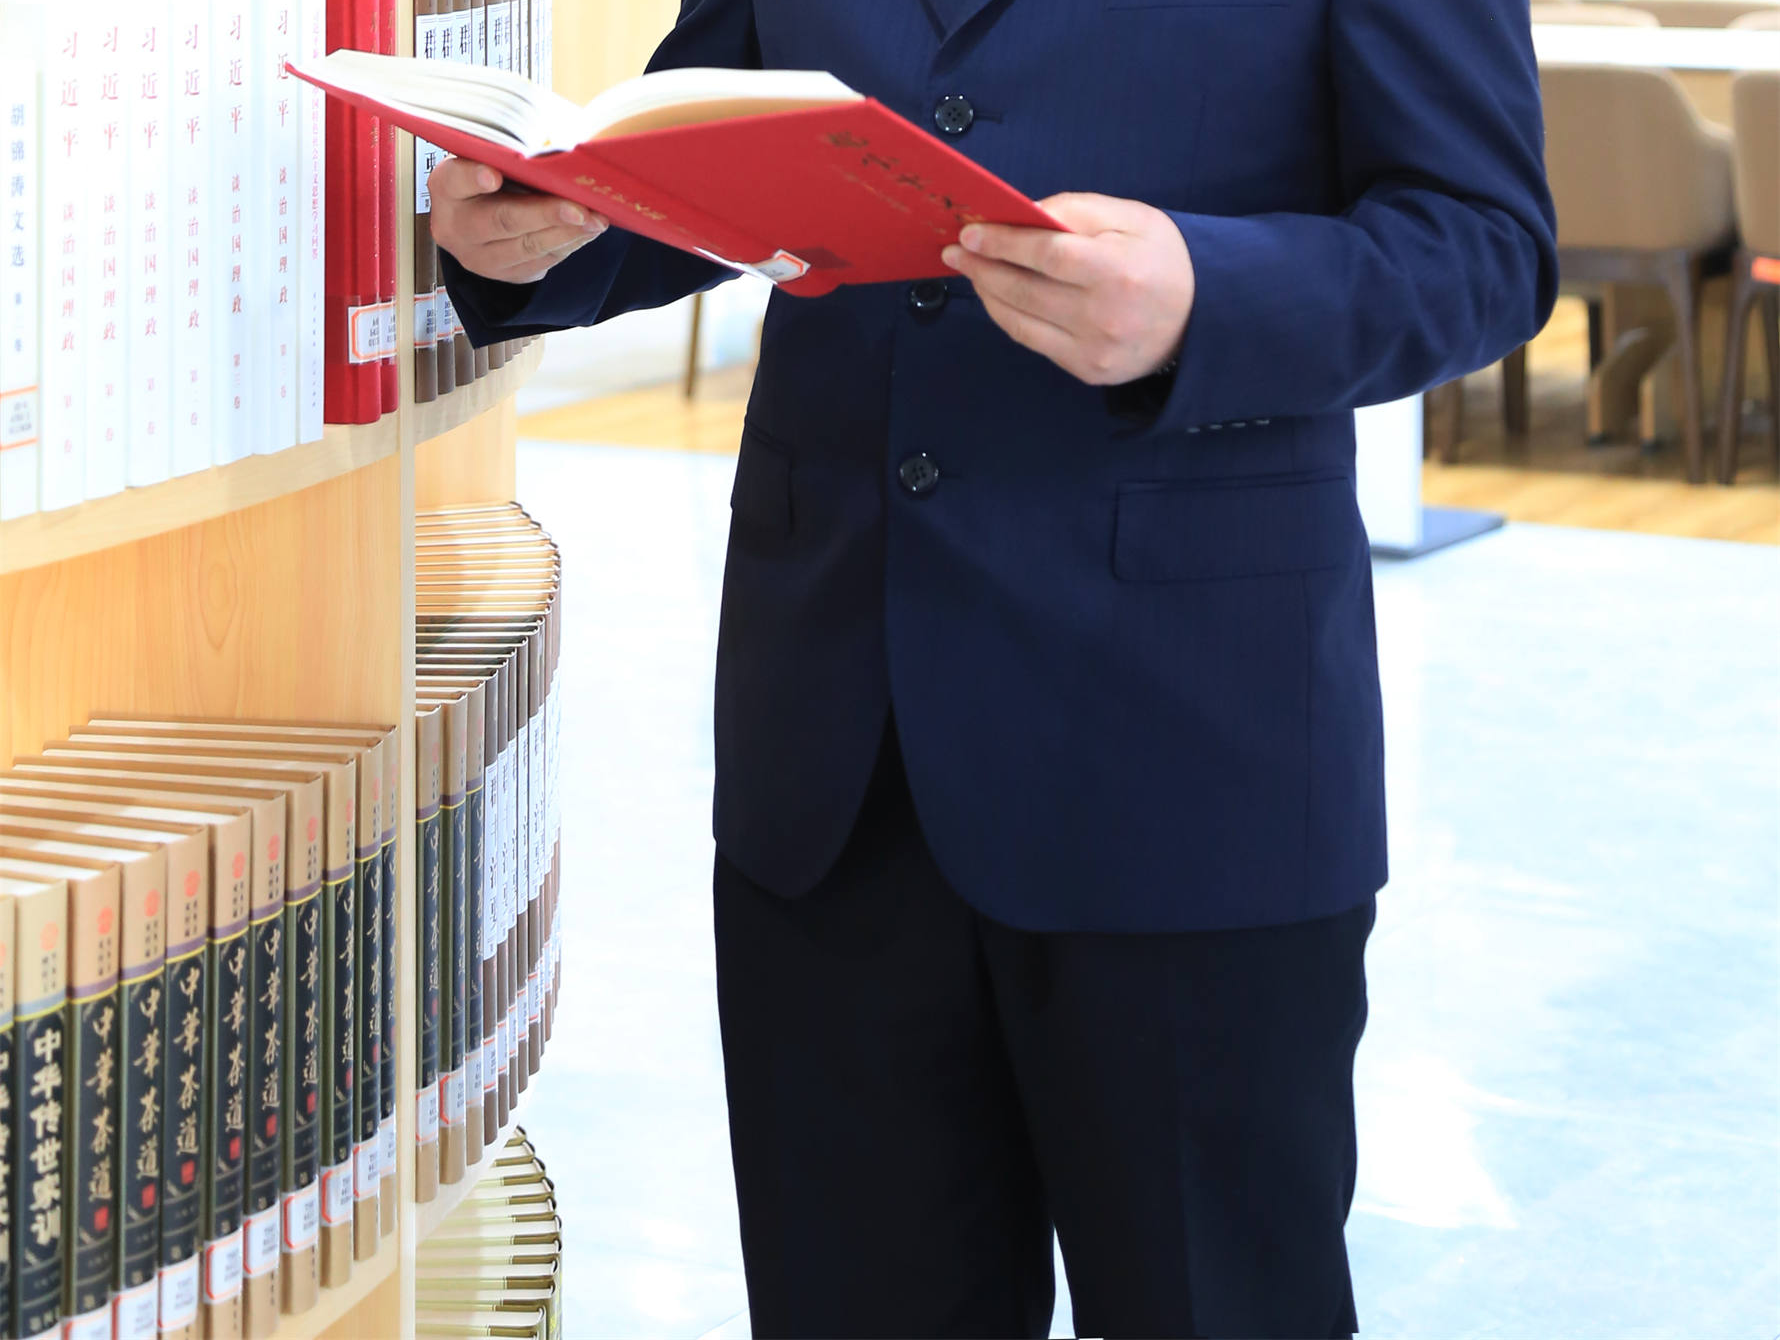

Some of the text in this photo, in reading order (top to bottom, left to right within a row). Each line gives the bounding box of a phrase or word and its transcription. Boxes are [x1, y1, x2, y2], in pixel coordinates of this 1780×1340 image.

[10, 104, 25, 267] 胡锦涛文选
[29, 1027, 62, 1246] 中华传世家训
